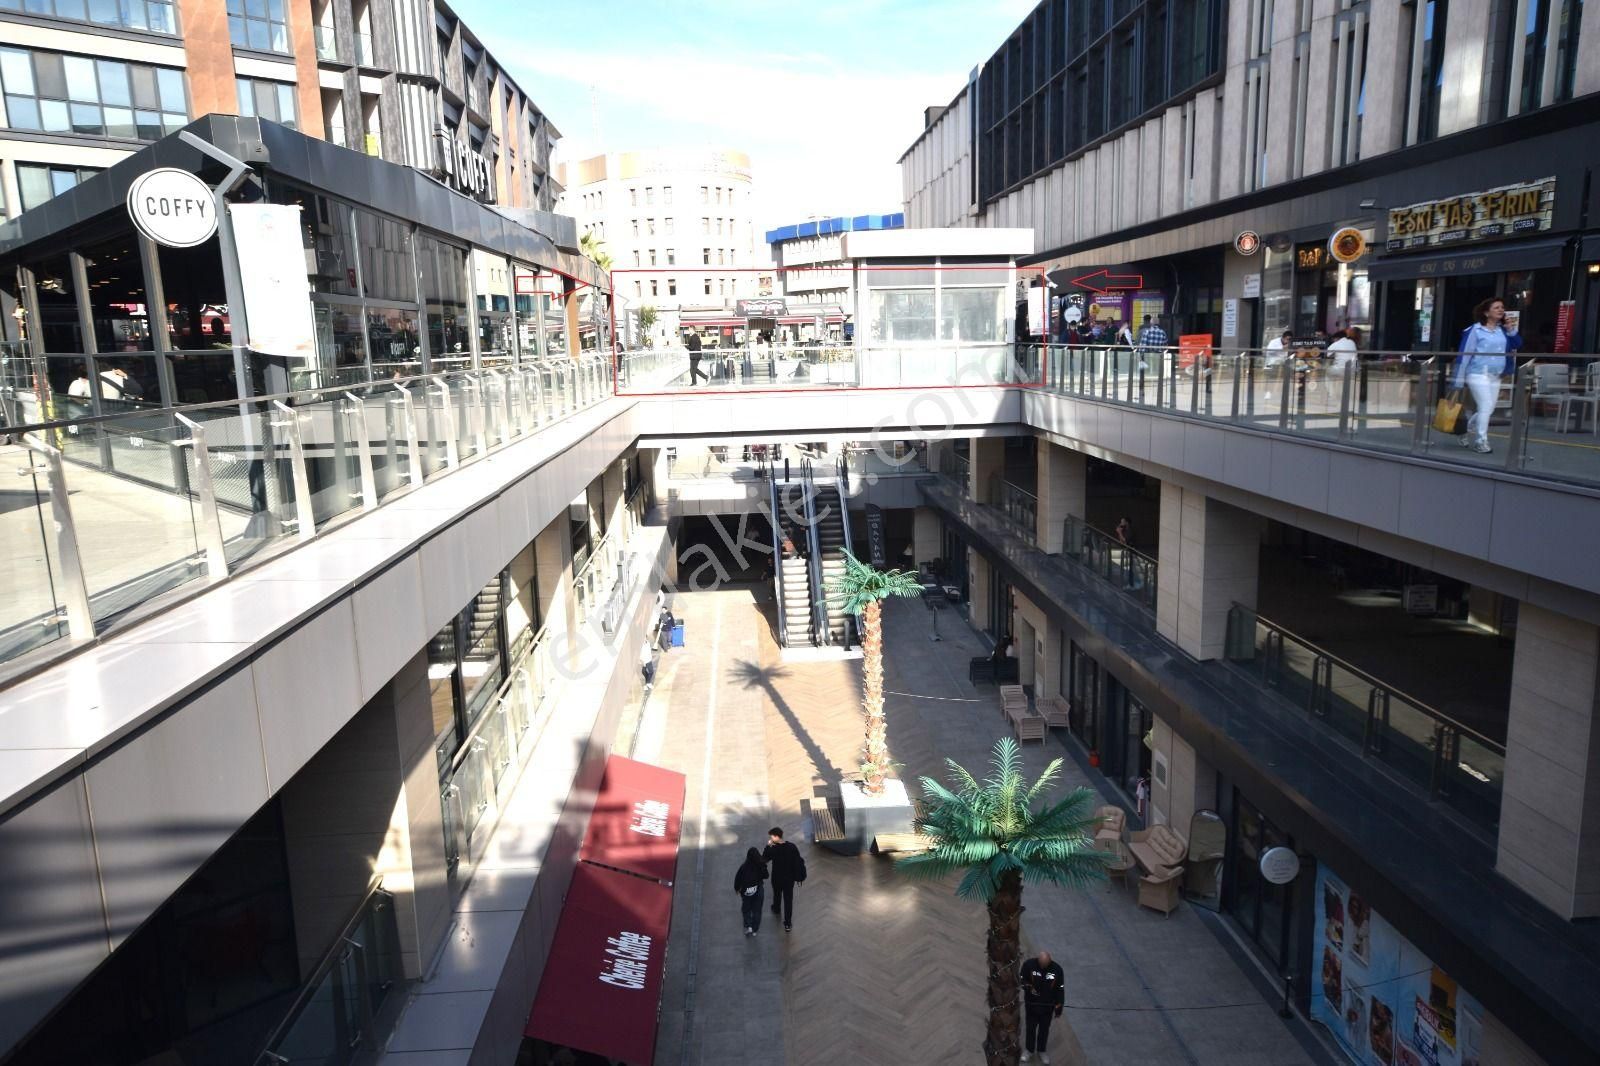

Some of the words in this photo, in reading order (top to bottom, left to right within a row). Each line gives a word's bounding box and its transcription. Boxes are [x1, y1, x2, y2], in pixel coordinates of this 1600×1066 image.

[146, 196, 206, 218] COFFY
[1478, 189, 1541, 220] FIRIN
[605, 931, 651, 961] Coffee
